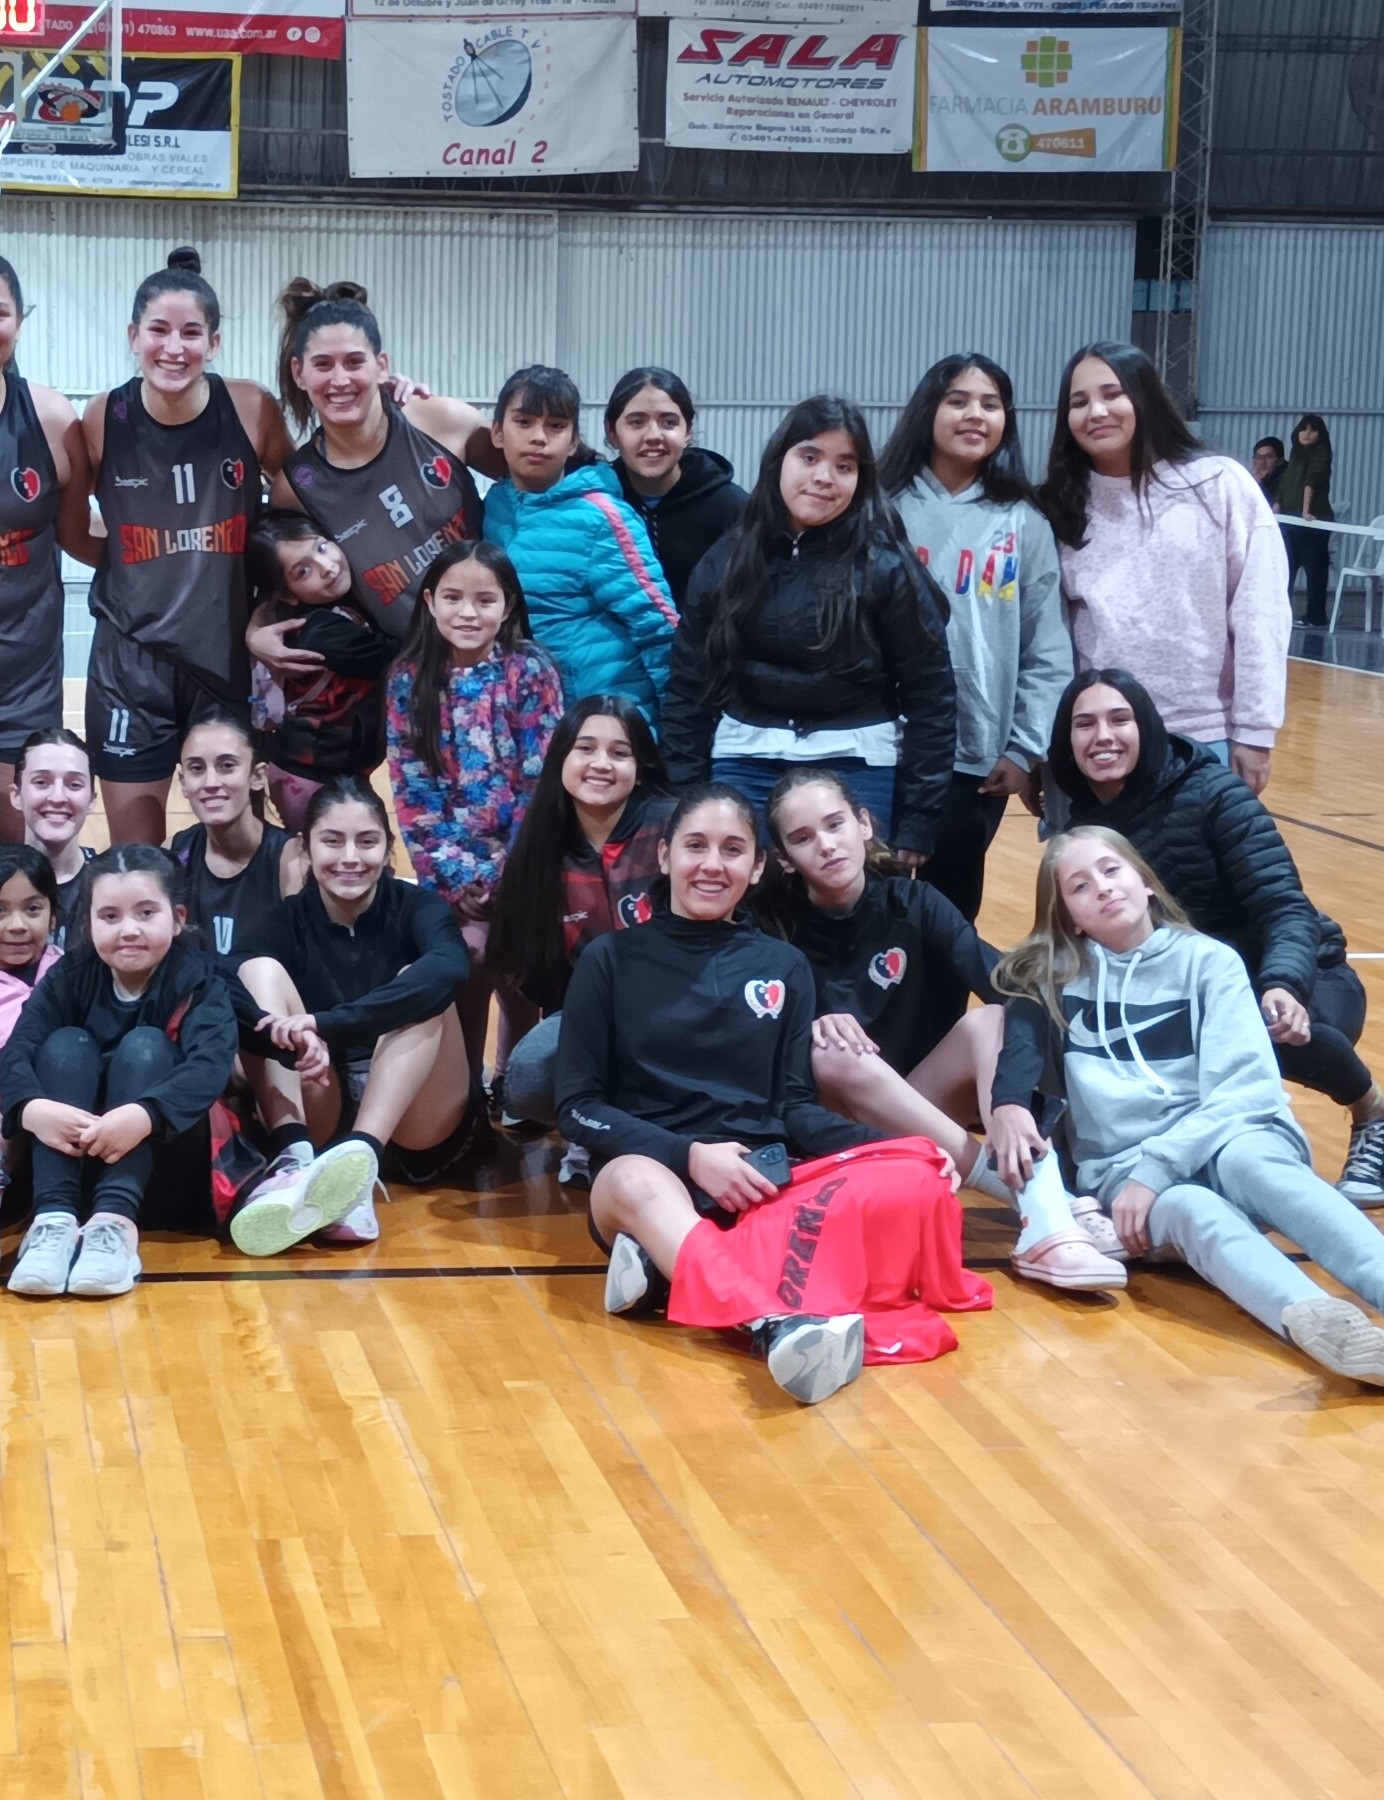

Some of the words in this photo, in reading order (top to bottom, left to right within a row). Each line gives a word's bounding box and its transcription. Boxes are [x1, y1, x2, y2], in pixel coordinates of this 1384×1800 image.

[45, 19, 74, 31] TADO
[676, 29, 906, 70] SALA
[442, 55, 466, 123] TOSTADO
[475, 25, 514, 48] CABLE
[696, 73, 887, 89] AUTOMOTORES
[683, 92, 725, 103] Servicio
[728, 94, 784, 105] Autorizado
[786, 97, 829, 107] RENAULT
[839, 98, 897, 108] CHEVROLET
[929, 95, 1028, 116] FARMACIA
[1032, 97, 1161, 116] ARAMBURU
[726, 107, 794, 120] Reparaciones
[798, 111, 810, 119] en
[813, 110, 854, 120] General
[128, 152, 167, 164] OBRAS
[170, 153, 208, 164] VIALES
[442, 140, 517, 165] Canal
[531, 140, 548, 164] 2
[51, 161, 66, 170] DE
[70, 162, 140, 173] MAQUINARIA
[161, 165, 204, 175] CEREAL
[172, 463, 195, 504] 11
[378, 484, 414, 529] 8
[120, 524, 160, 565] SAN
[991, 529, 1016, 554] 23
[362, 560, 411, 607] SAN
[109, 708, 129, 743] 11
